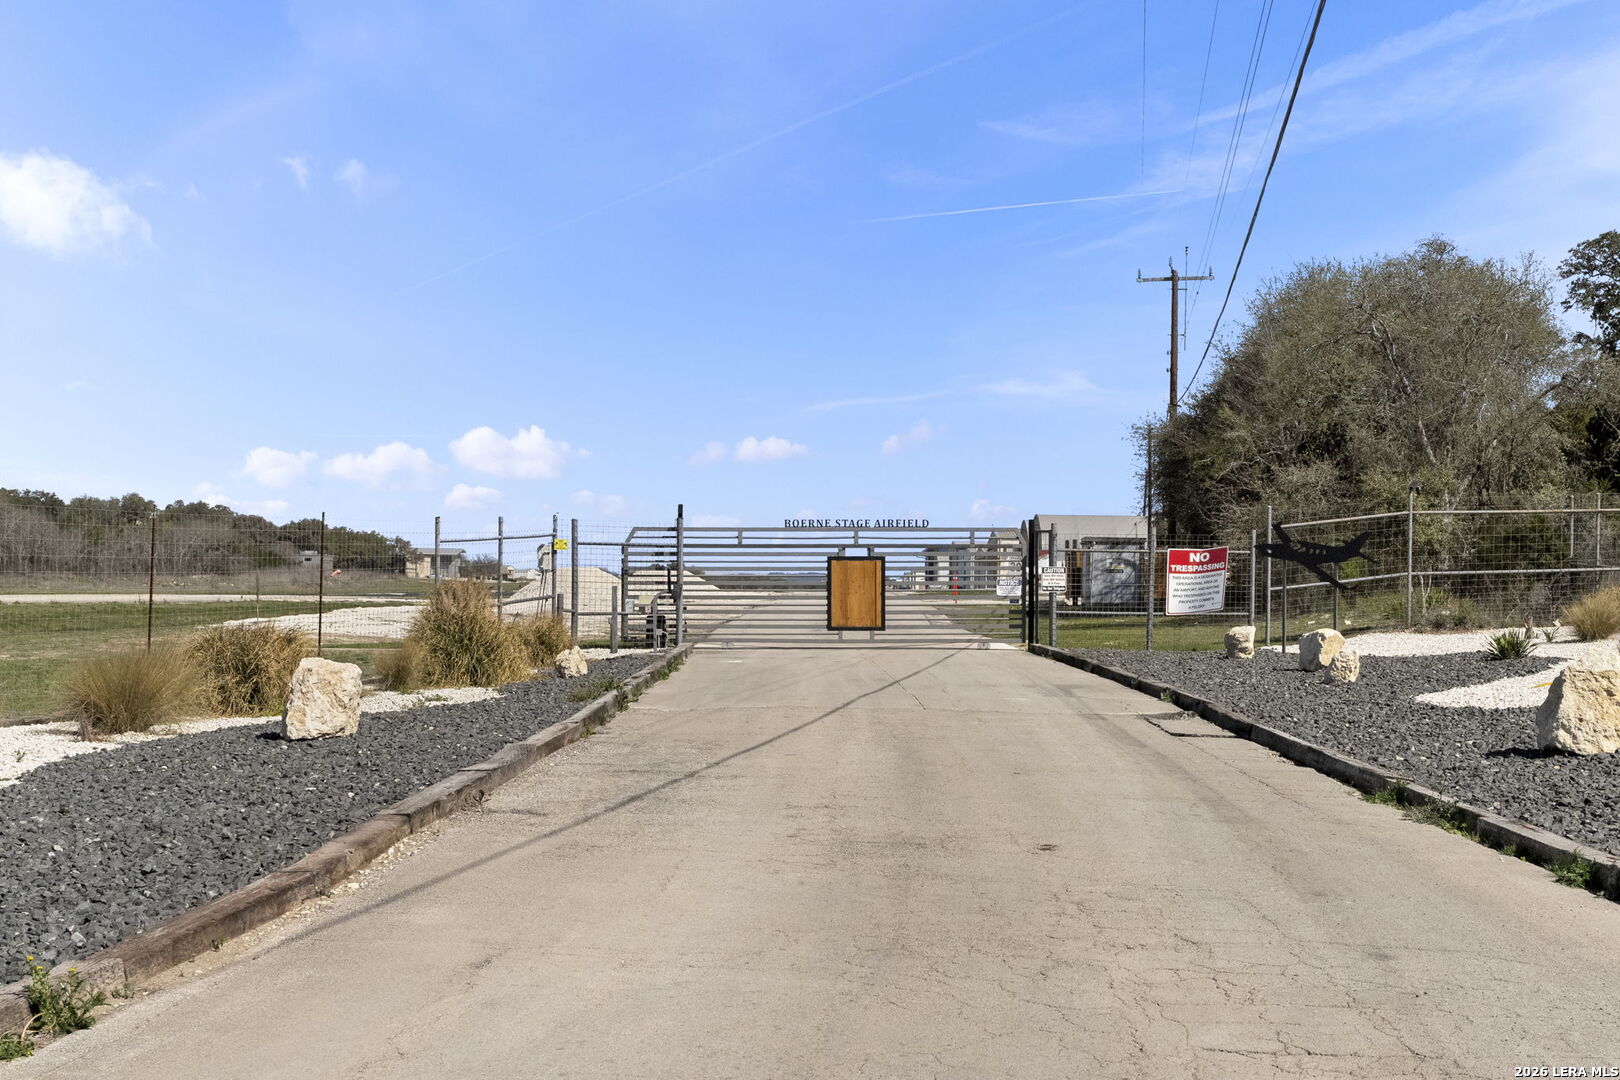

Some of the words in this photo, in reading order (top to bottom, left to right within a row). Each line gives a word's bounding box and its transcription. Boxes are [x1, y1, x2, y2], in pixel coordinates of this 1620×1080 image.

[784, 519, 831, 528] BOERNE
[835, 519, 871, 528] STAGE
[874, 519, 930, 528] AIRFIELD
[1189, 552, 1210, 562] NO
[1170, 562, 1225, 572] TRESPASSING
